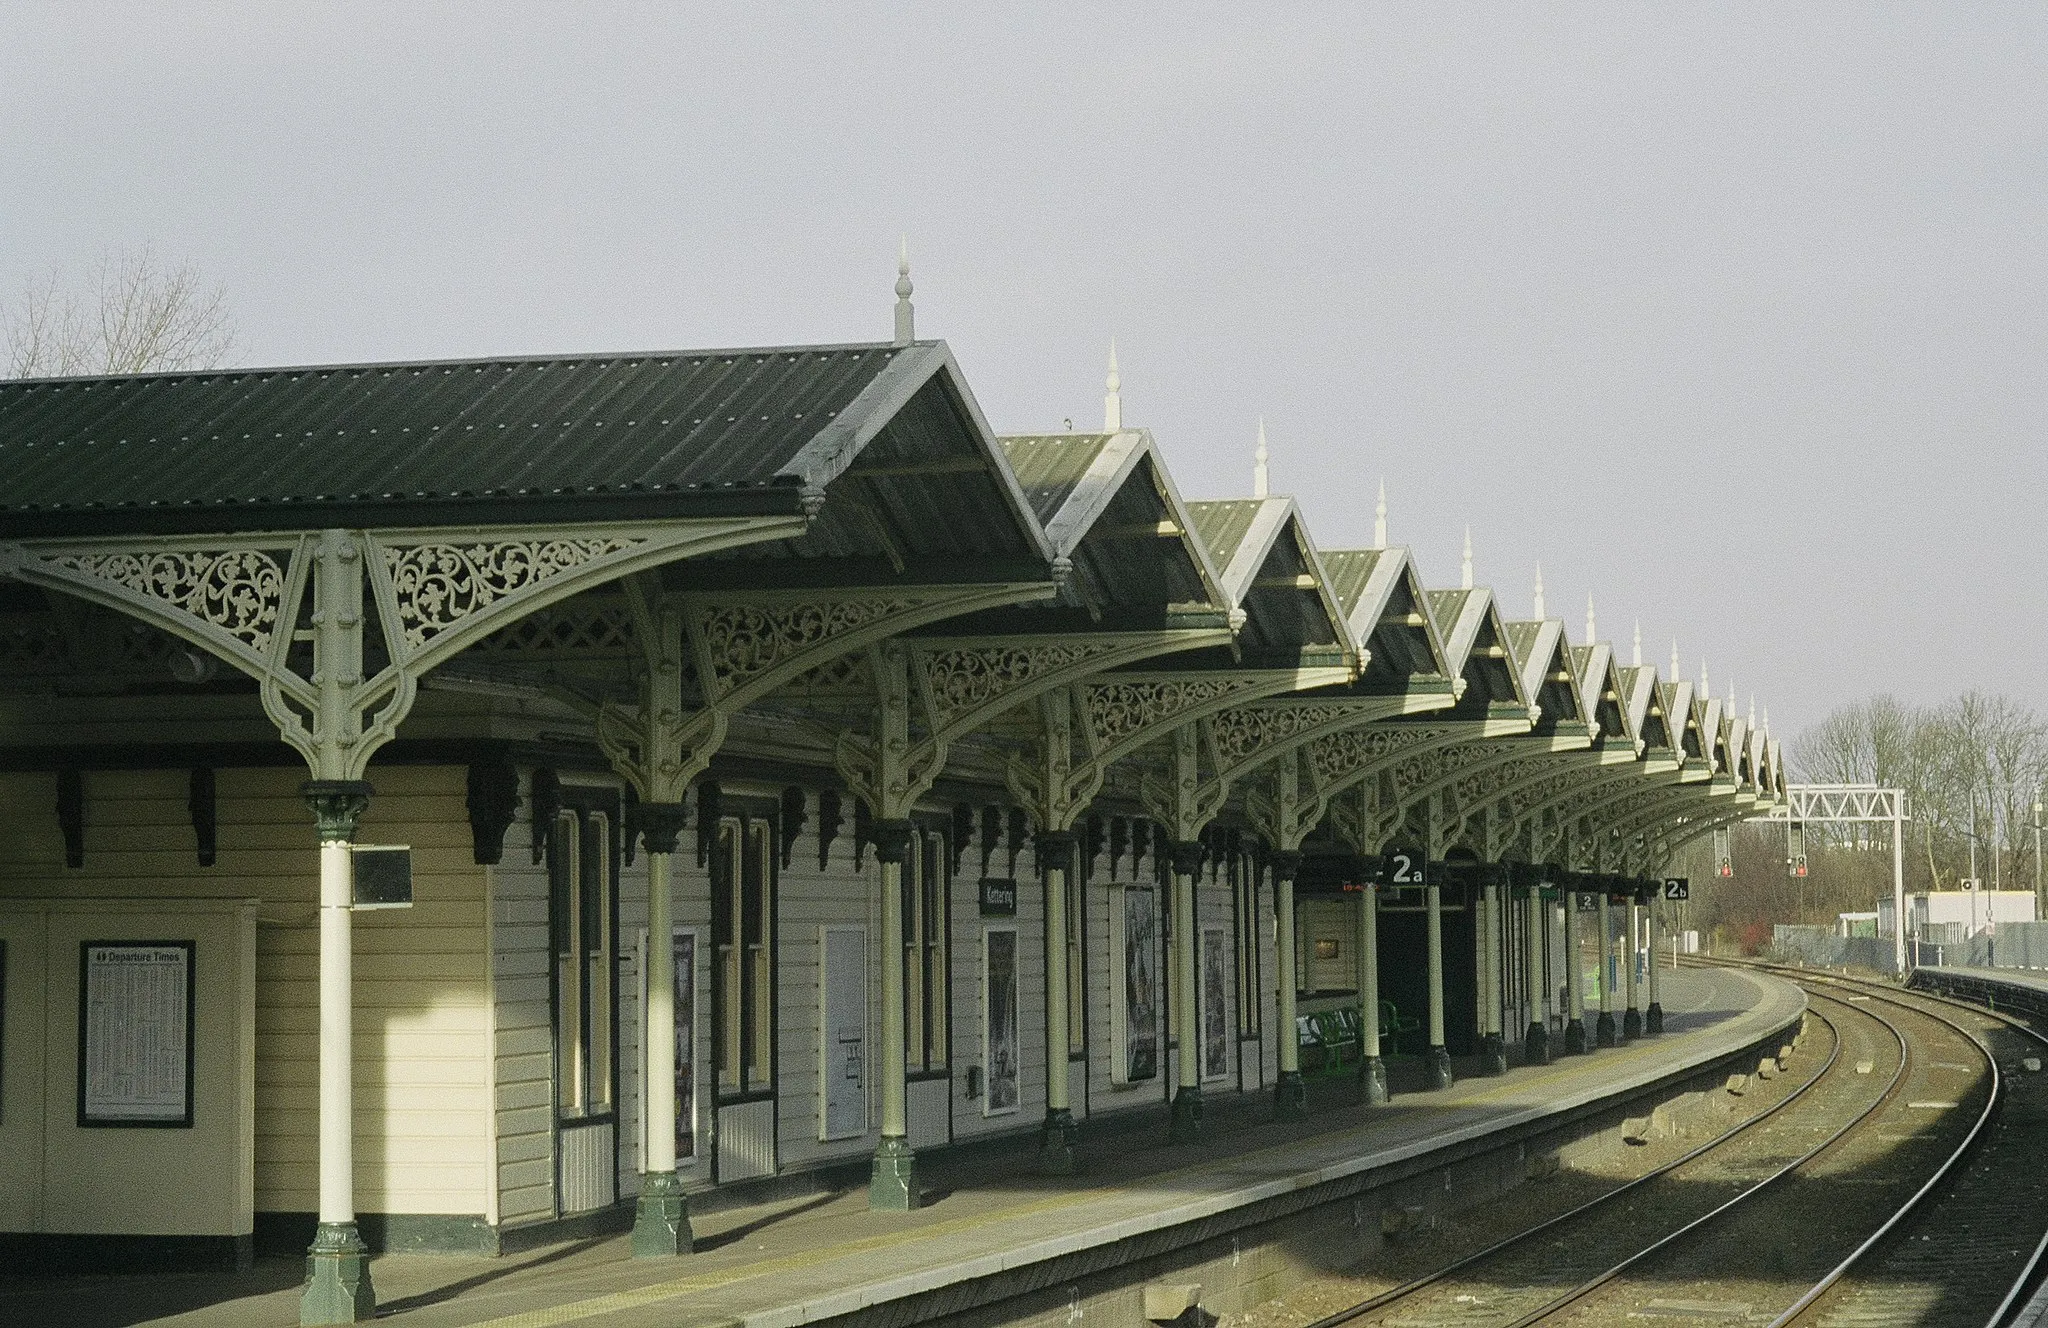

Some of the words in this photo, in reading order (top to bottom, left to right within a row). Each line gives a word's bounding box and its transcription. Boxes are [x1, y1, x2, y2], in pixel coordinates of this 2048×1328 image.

[1393, 855, 1423, 883] 2a
[1667, 880, 1687, 898] 2b
[1584, 895, 1593, 907] 2
[109, 951, 152, 963] Departure
[153, 951, 180, 962] Times
